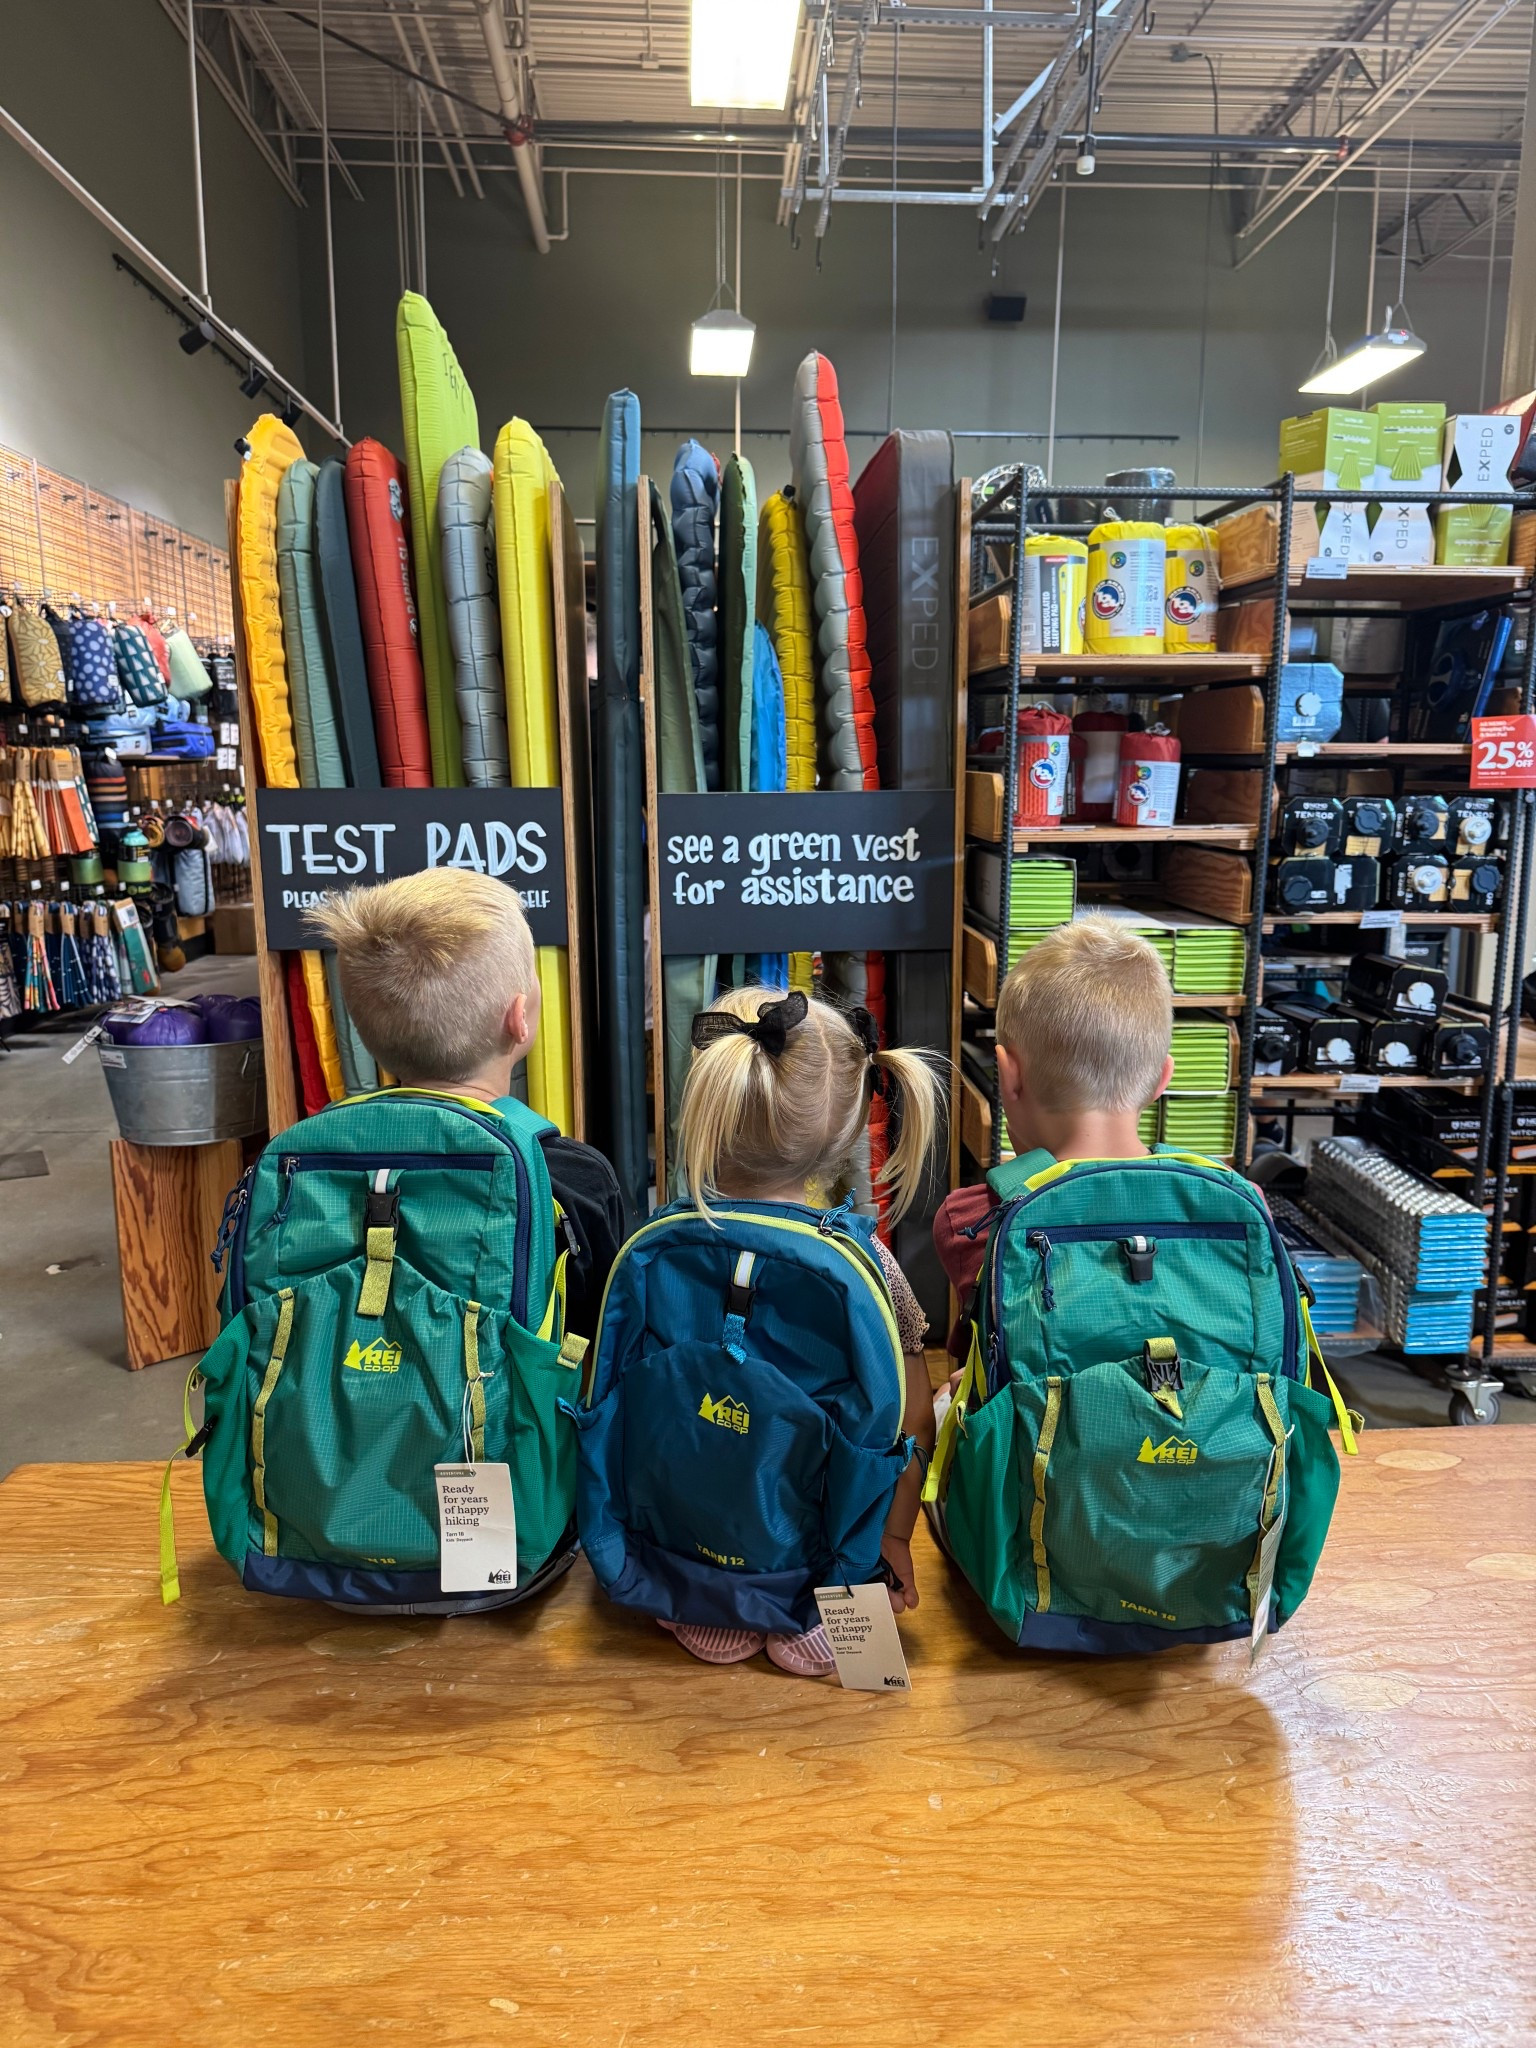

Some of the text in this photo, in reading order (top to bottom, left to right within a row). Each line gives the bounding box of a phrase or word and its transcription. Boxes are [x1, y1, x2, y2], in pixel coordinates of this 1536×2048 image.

[1478, 427, 1493, 482] EXPED
[1396, 506, 1410, 550] XPED
[912, 537, 939, 670] EXPED
[1050, 604, 1059, 616] PAD
[1042, 591, 1051, 648] DIVIDE INSULATED
[1051, 618, 1060, 648] SLEEPING
[1514, 760, 1534, 768] OFF
[1294, 811, 1334, 820] TENSOR
[265, 821, 548, 876] TEST PADS
[666, 827, 921, 876] see a green vest
[672, 866, 915, 906] for assistance
[282, 890, 551, 909] PLEAS SELF
[364, 1350, 402, 1366] REI
[717, 1406, 750, 1428] REI
[1158, 1447, 1198, 1460] REI
[442, 1484, 474, 1495] Ready
[443, 1496, 488, 1506] for years
[444, 1506, 490, 1516] of happy
[446, 1516, 480, 1526] hiking
[730, 1556, 745, 1566] 12
[824, 1606, 855, 1616] Ready
[1120, 1600, 1158, 1616] TARN
[826, 1616, 870, 1625] for years
[830, 1625, 873, 1634] of happy
[832, 1634, 866, 1642] hiking
